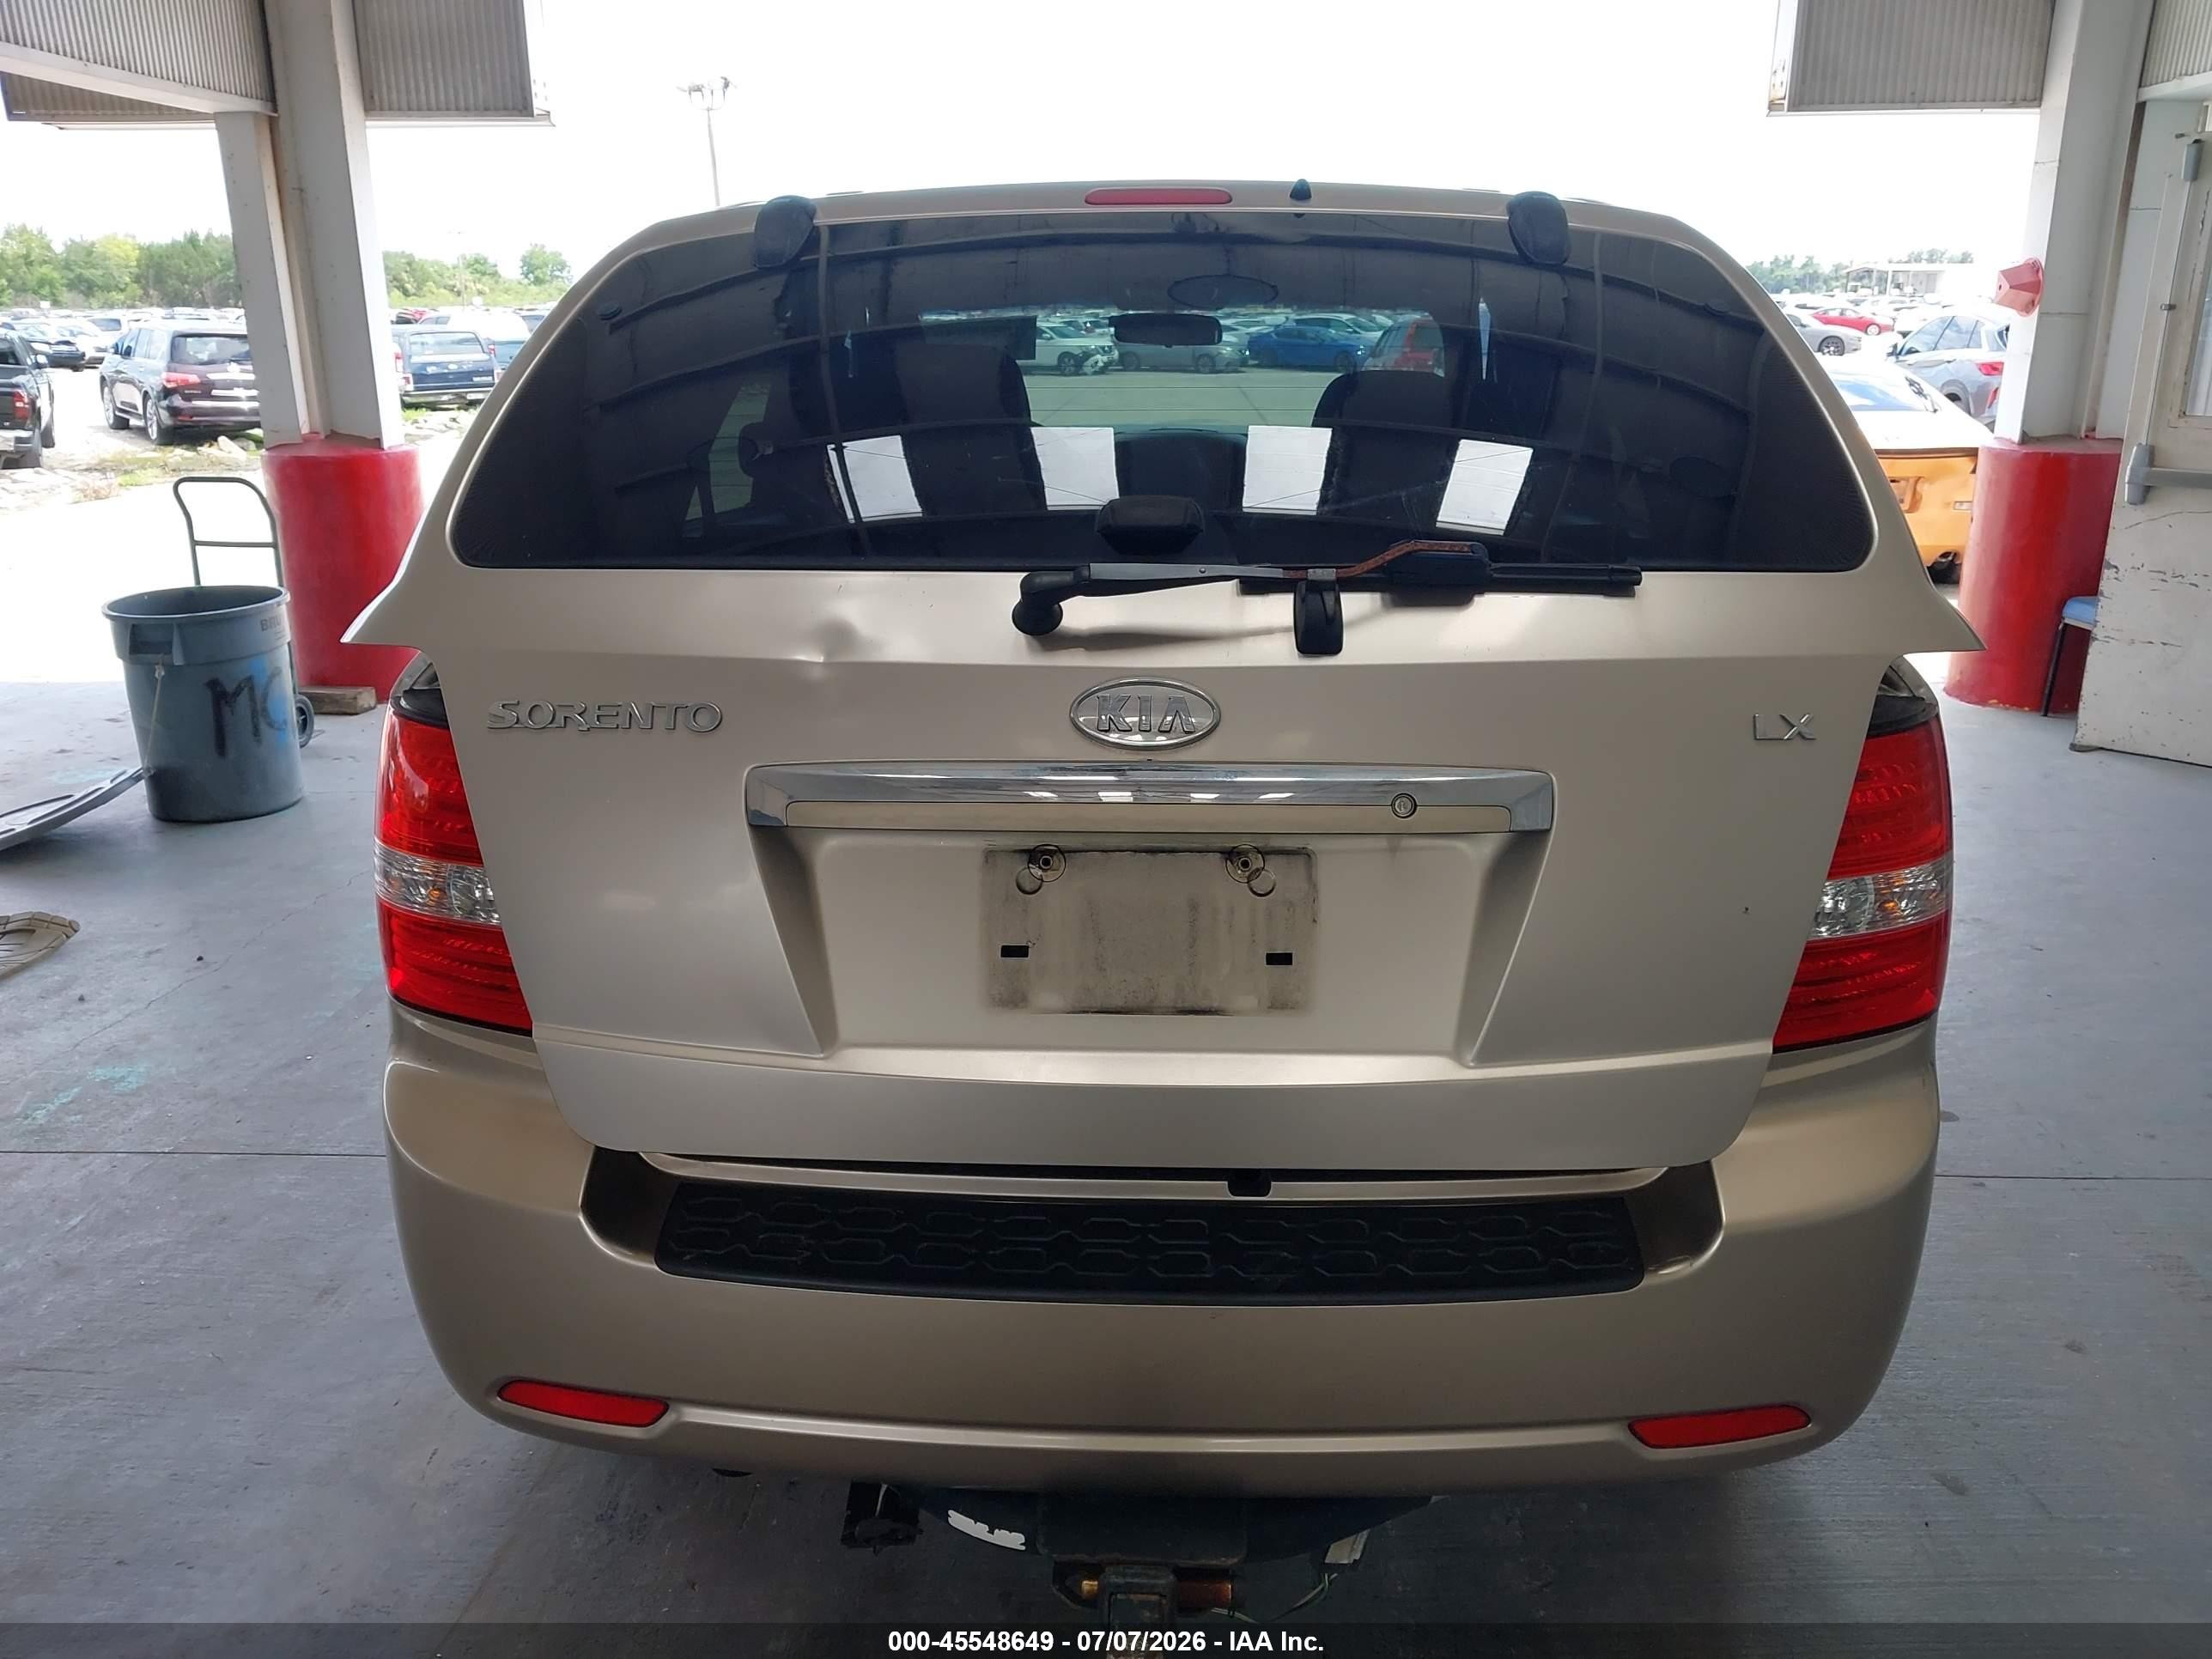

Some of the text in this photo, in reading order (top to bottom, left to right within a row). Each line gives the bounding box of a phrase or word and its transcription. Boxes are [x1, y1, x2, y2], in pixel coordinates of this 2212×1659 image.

[487, 700, 723, 732] SORENTO
[1097, 694, 1196, 734] KIA
[1753, 713, 1816, 741] LX
